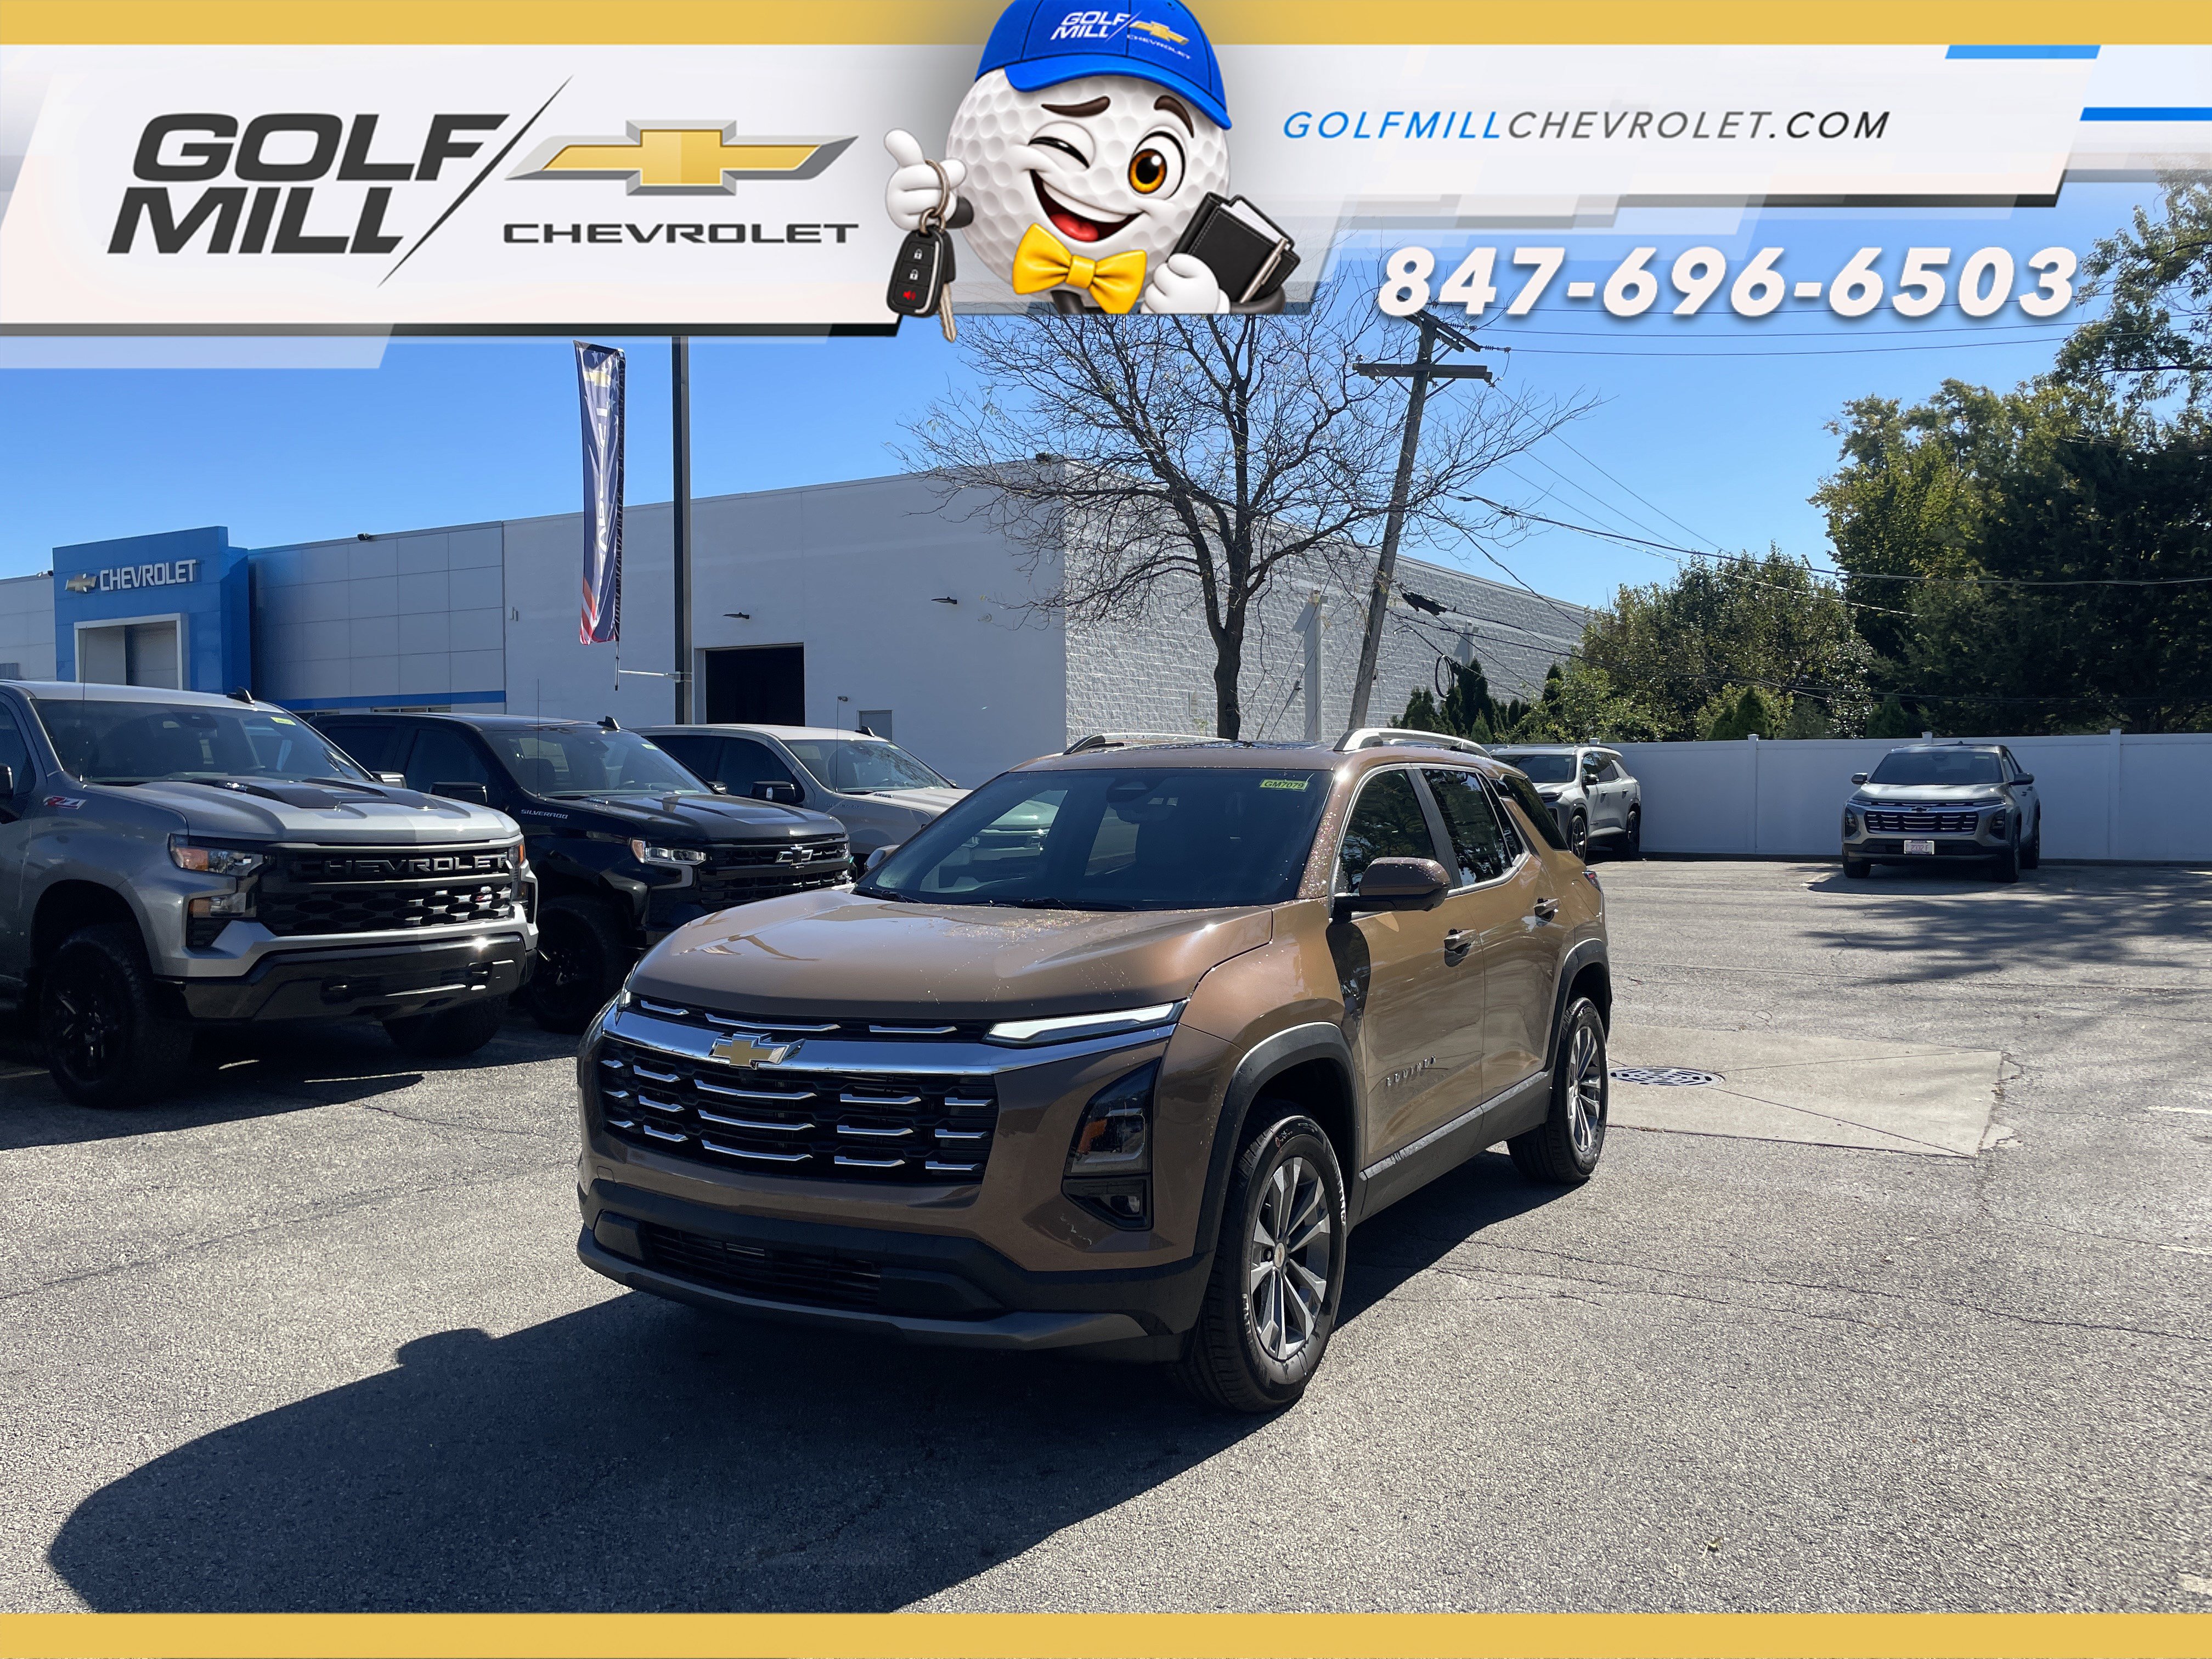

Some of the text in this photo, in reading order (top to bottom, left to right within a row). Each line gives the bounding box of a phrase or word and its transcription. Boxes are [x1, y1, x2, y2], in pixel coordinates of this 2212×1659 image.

[100, 560, 196, 591] CHEVROLET
[1264, 781, 1305, 789] GM7079
[521, 809, 568, 819] SILVERADO
